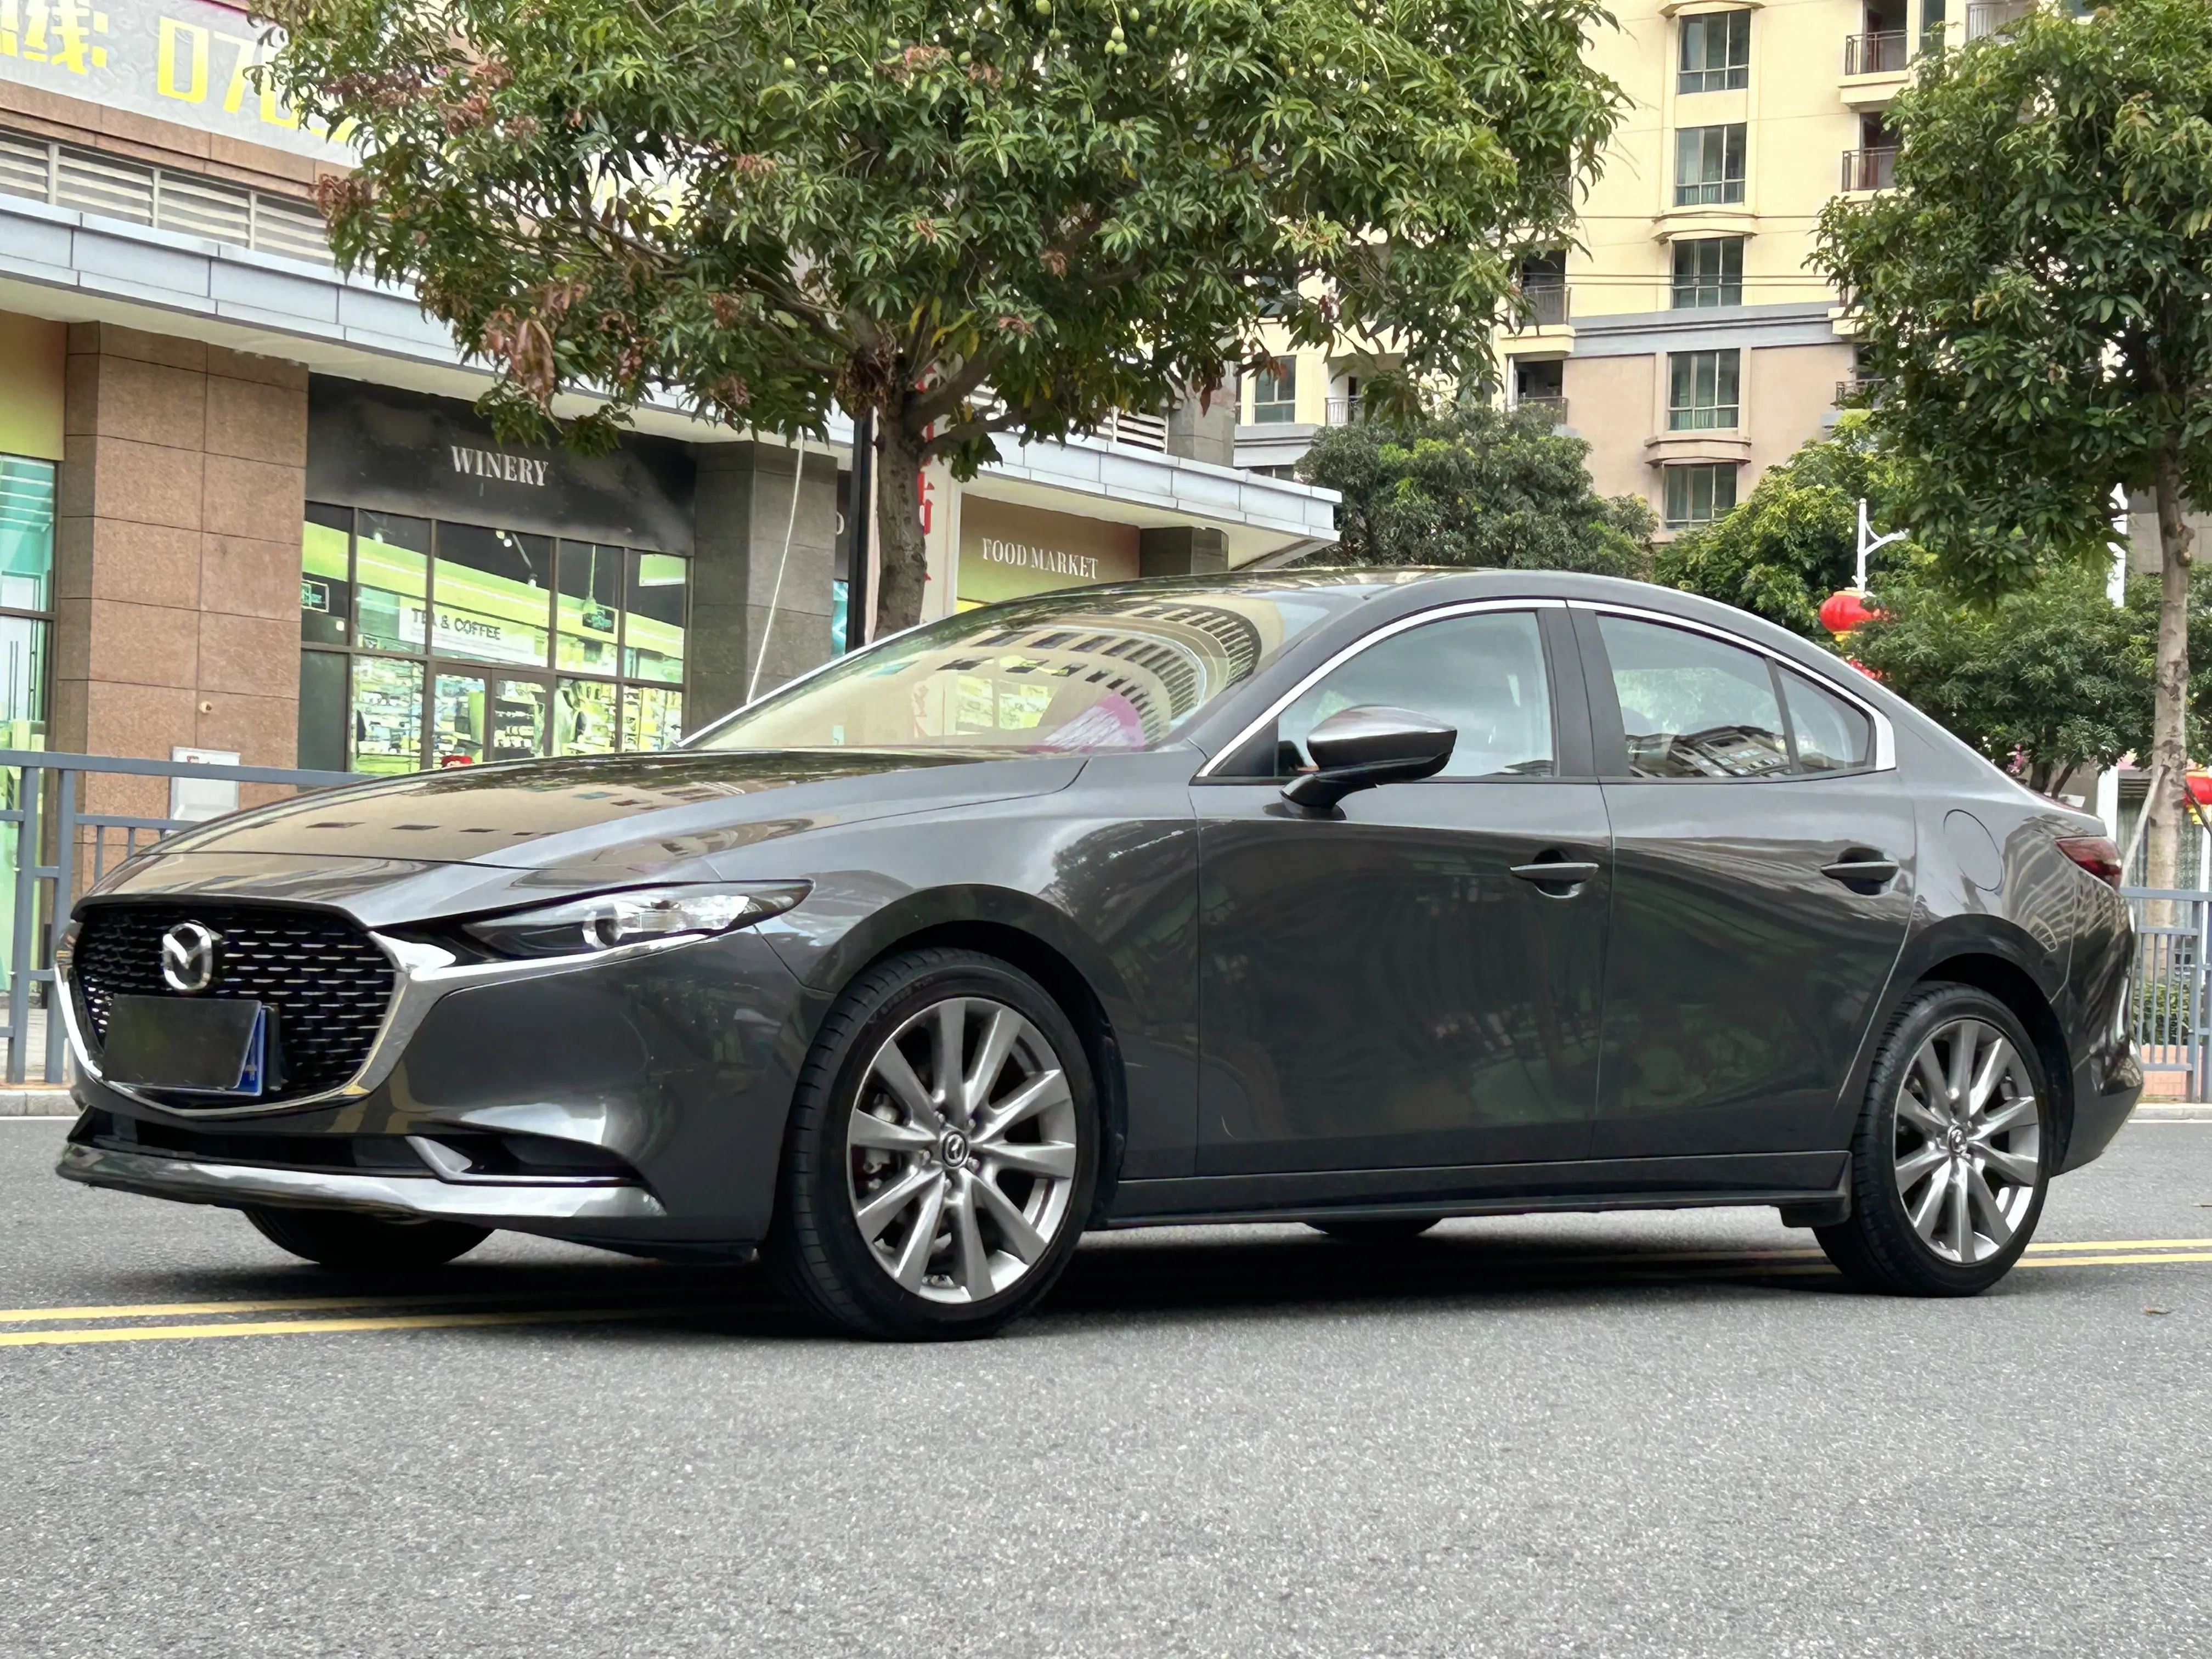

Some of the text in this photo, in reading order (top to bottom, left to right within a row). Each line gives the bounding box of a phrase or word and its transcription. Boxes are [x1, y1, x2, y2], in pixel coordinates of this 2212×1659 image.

[451, 445, 549, 486] WINERY
[983, 538, 1098, 579] FOOD MARKET
[411, 607, 437, 627] TE
[441, 614, 450, 630] &
[454, 617, 501, 640] COFFEE
